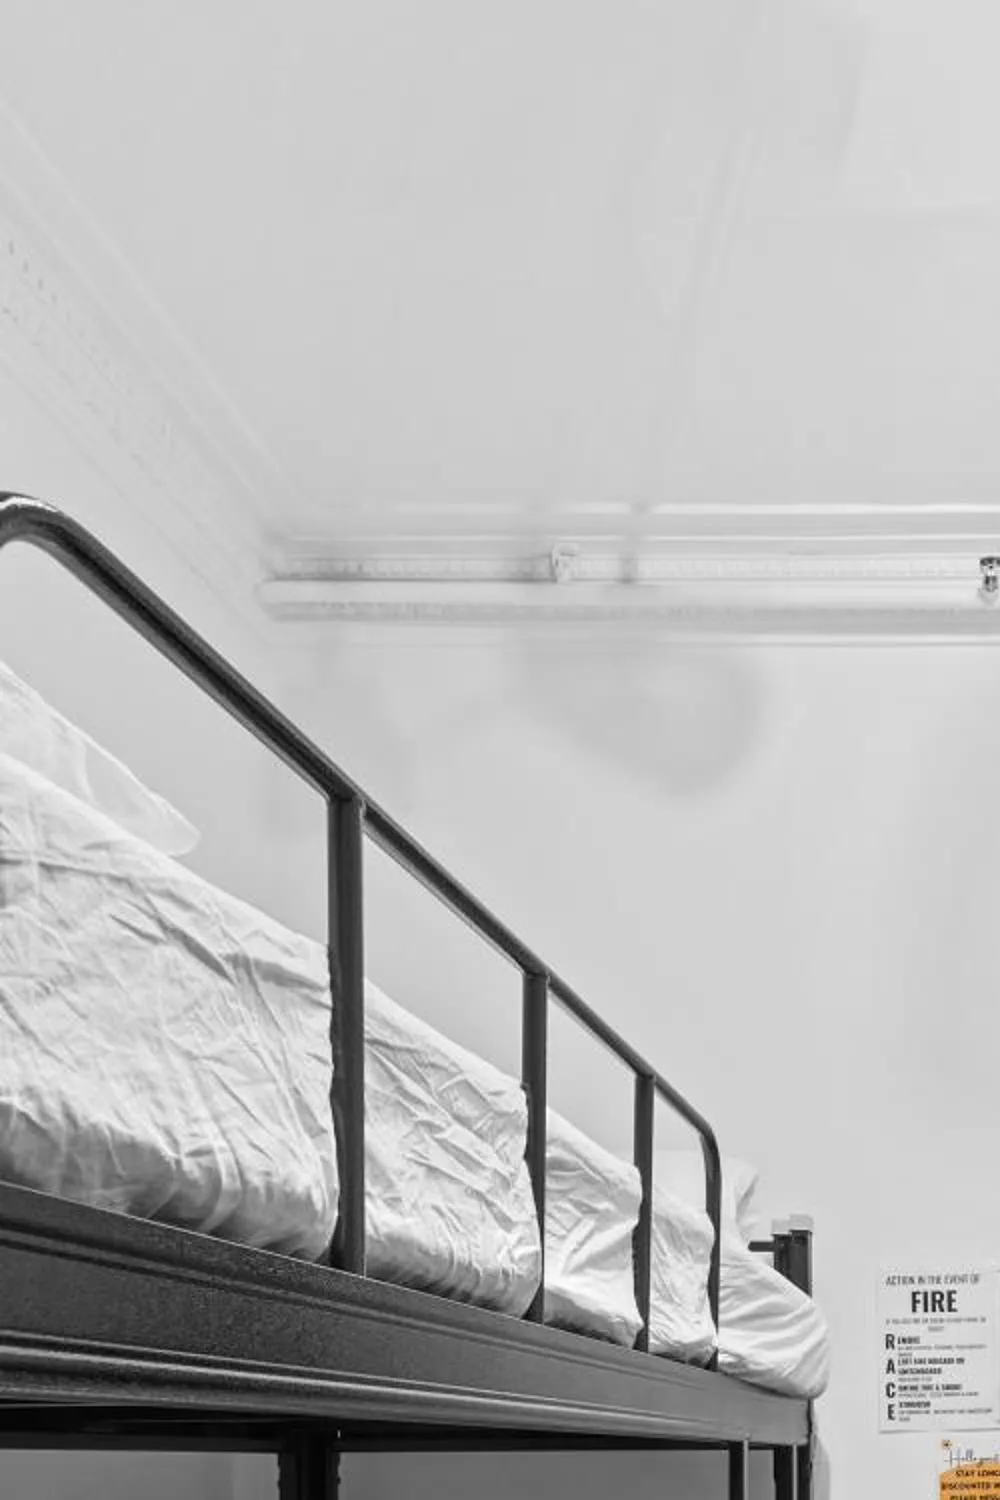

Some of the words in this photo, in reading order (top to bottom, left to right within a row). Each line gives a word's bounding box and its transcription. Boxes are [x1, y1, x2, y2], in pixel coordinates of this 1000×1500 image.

[928, 1274, 942, 1285] THE
[911, 1290, 958, 1313] FIRE
[885, 1333, 895, 1350] R
[885, 1358, 896, 1374] A
[885, 1382, 896, 1398] C
[956, 1469, 974, 1477] STAY
